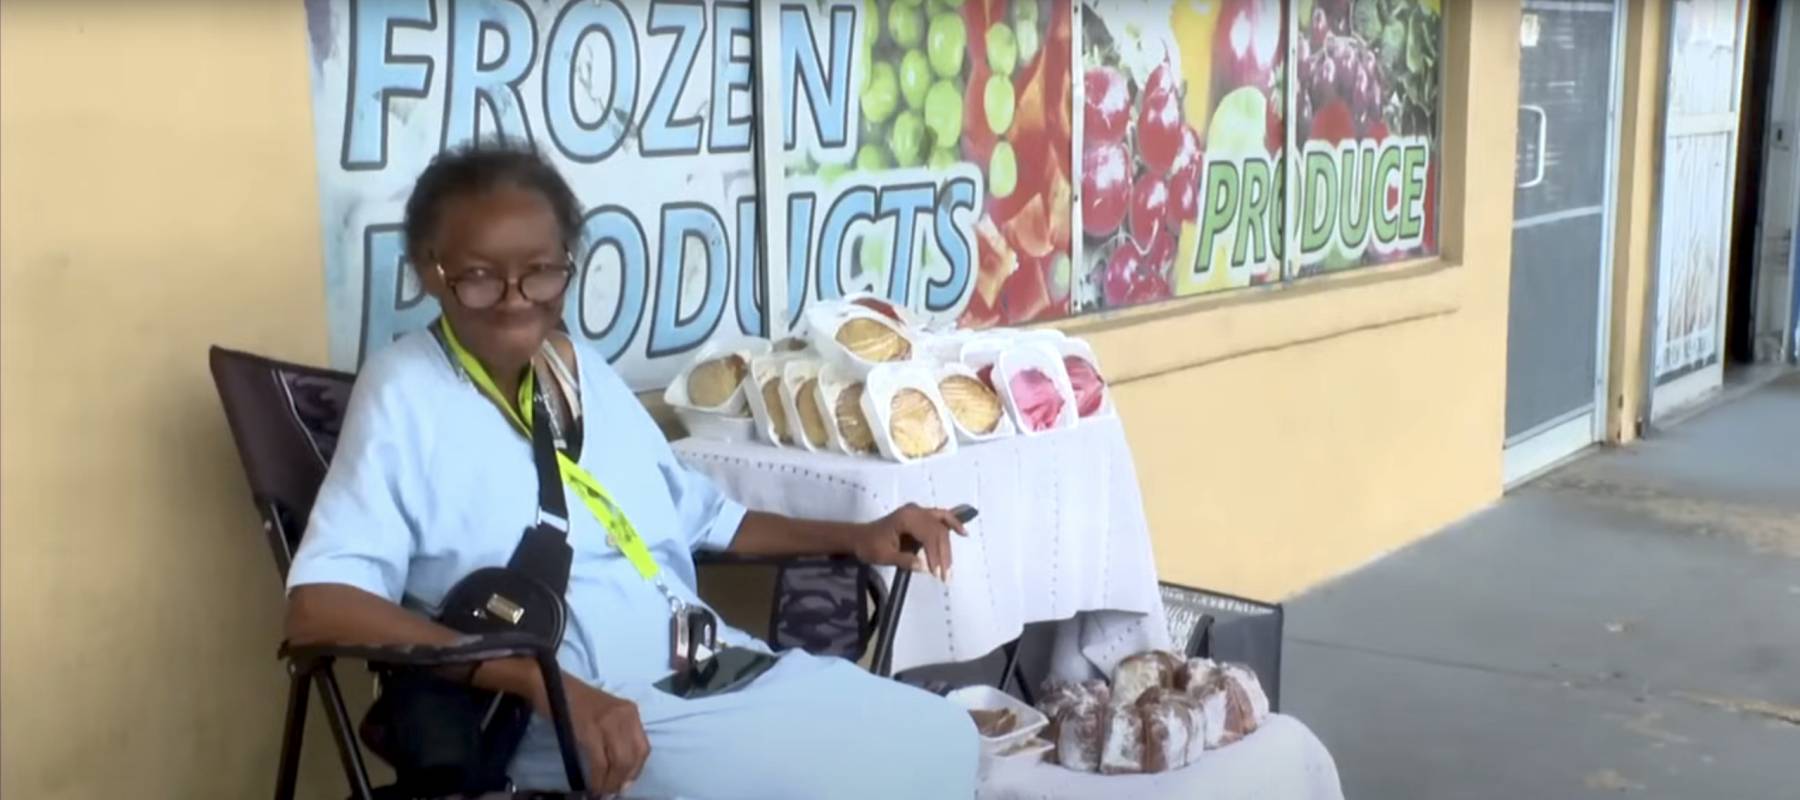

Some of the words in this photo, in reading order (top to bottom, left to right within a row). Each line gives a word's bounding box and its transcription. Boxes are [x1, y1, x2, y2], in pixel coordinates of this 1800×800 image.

[341, 0, 856, 170] FROZEN
[356, 177, 976, 374] PODUCTS
[1194, 145, 1426, 273] PRODUCE
